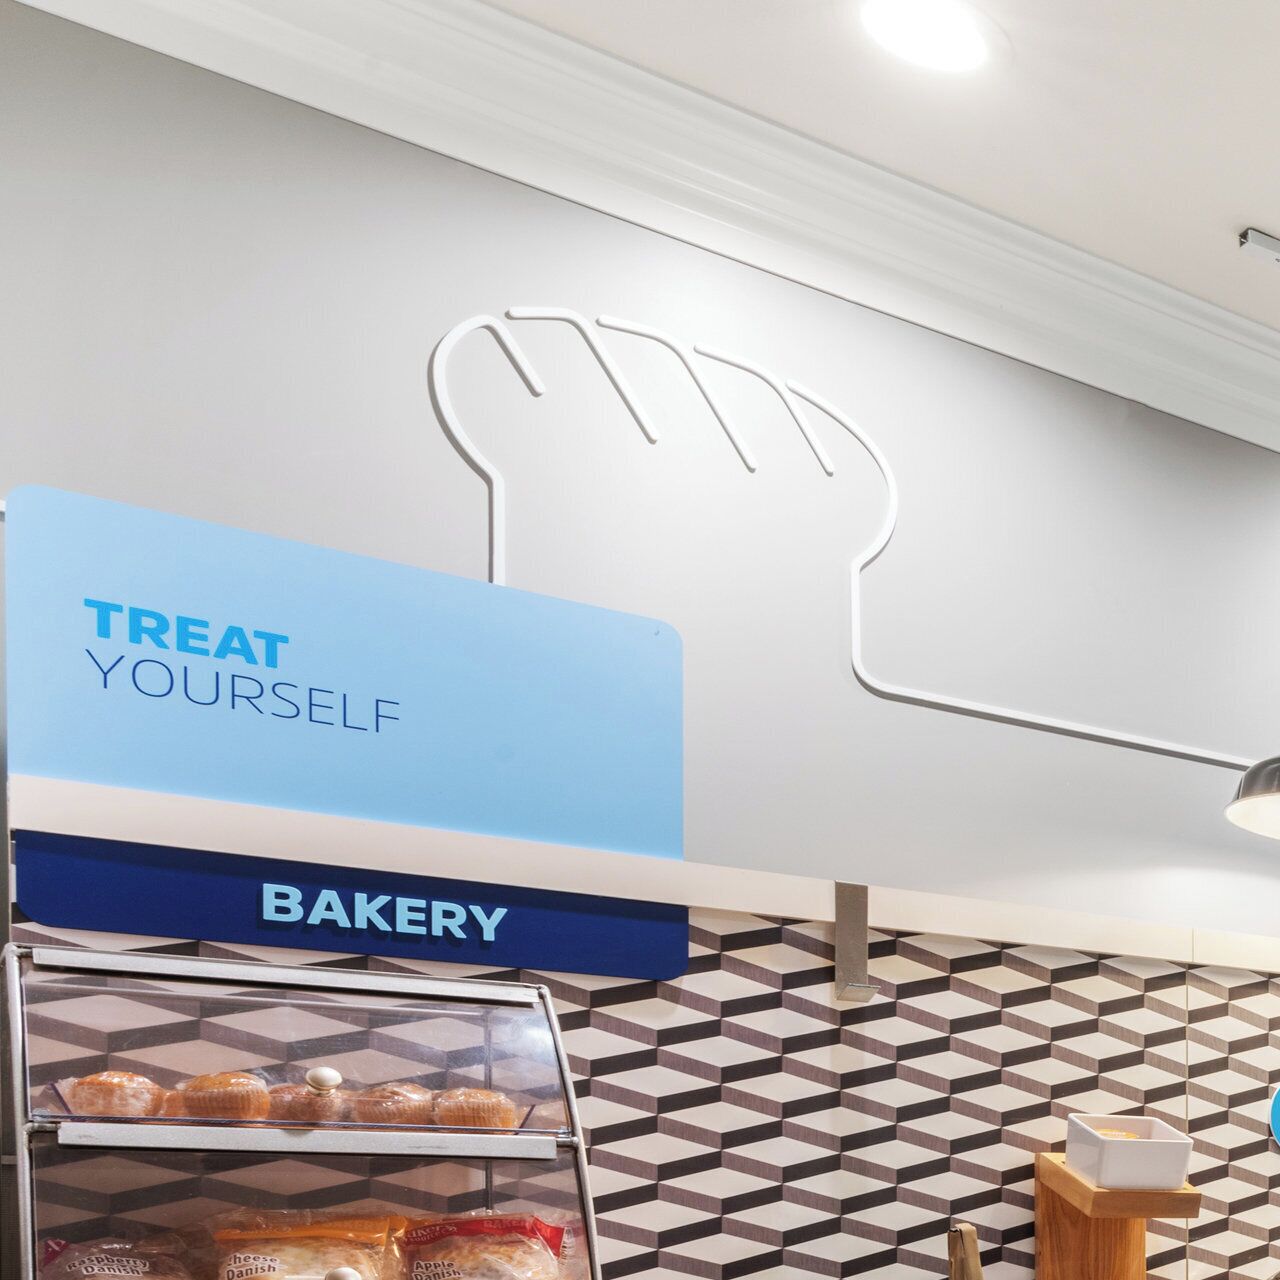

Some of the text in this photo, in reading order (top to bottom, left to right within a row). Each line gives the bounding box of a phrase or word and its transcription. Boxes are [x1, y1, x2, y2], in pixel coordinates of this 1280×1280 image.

[84, 598, 289, 669] TREAT
[85, 648, 400, 733] YOURSELF
[262, 882, 508, 943] BAKERY
[66, 1253, 149, 1272] Raspberry
[83, 1264, 141, 1276] Danish
[226, 1264, 277, 1280] Danish
[414, 1261, 454, 1272] Apple
